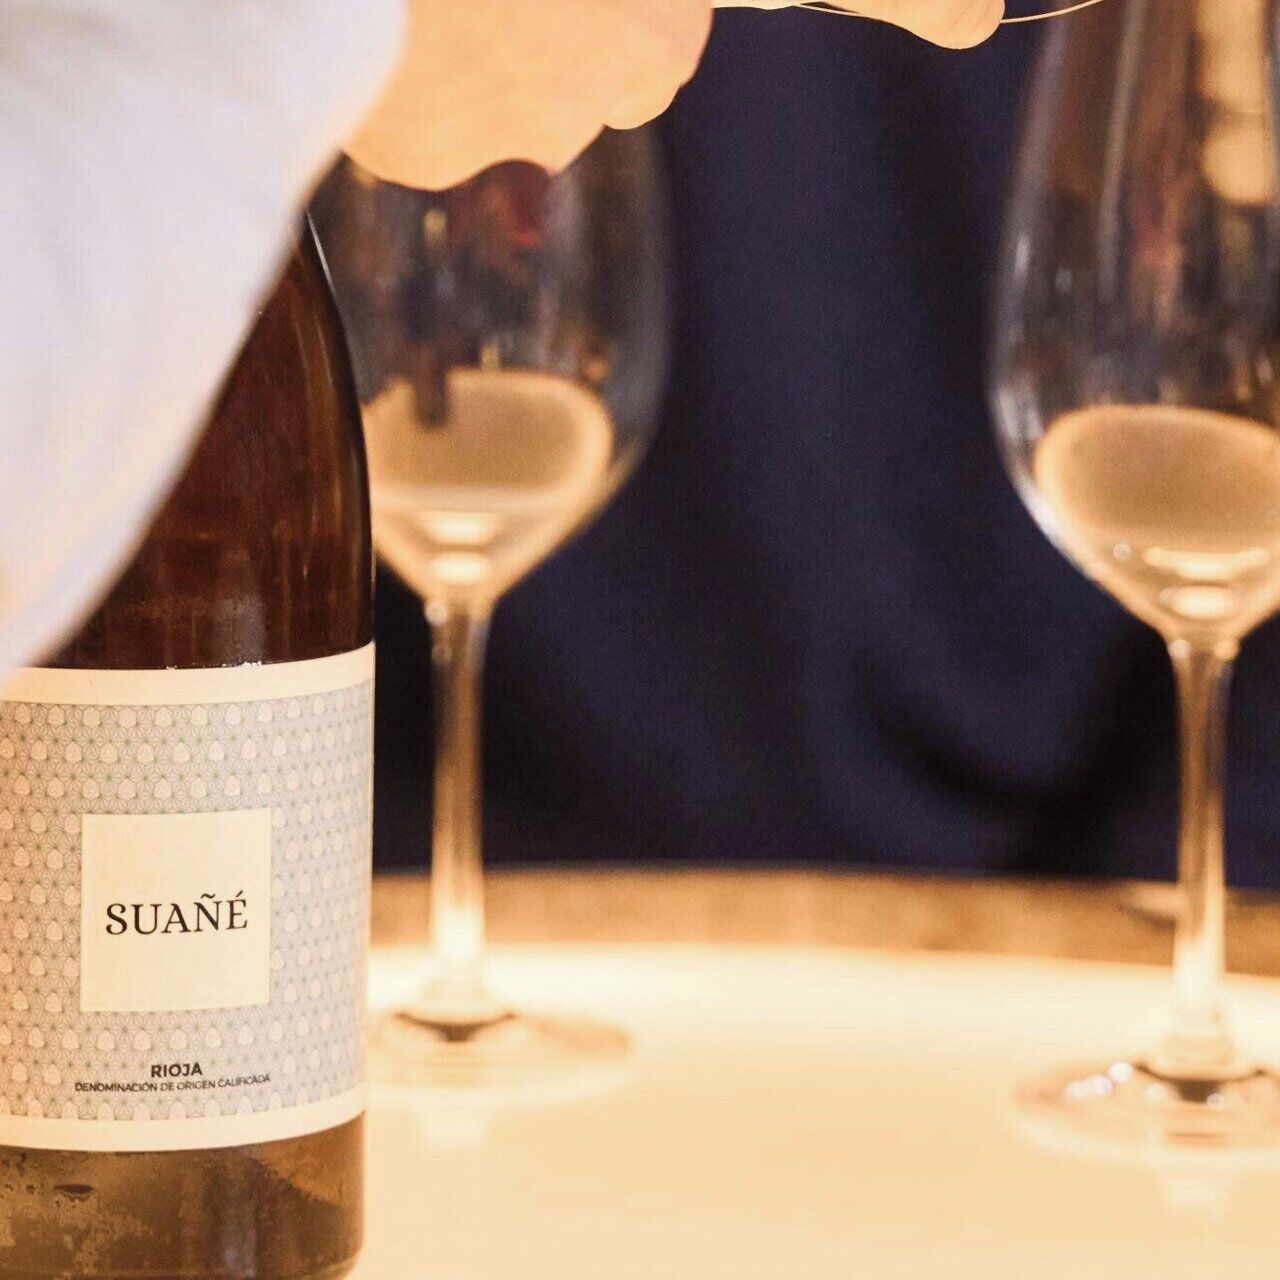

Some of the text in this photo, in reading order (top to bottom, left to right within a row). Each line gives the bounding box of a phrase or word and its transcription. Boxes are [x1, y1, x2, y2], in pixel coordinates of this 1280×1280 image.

[105, 889, 249, 936] SUAÑÉ
[150, 1062, 203, 1078] RIOJA
[160, 1081, 174, 1091] DE
[176, 1080, 216, 1091] ORIGEN
[217, 1073, 271, 1088] CALIFICADA
